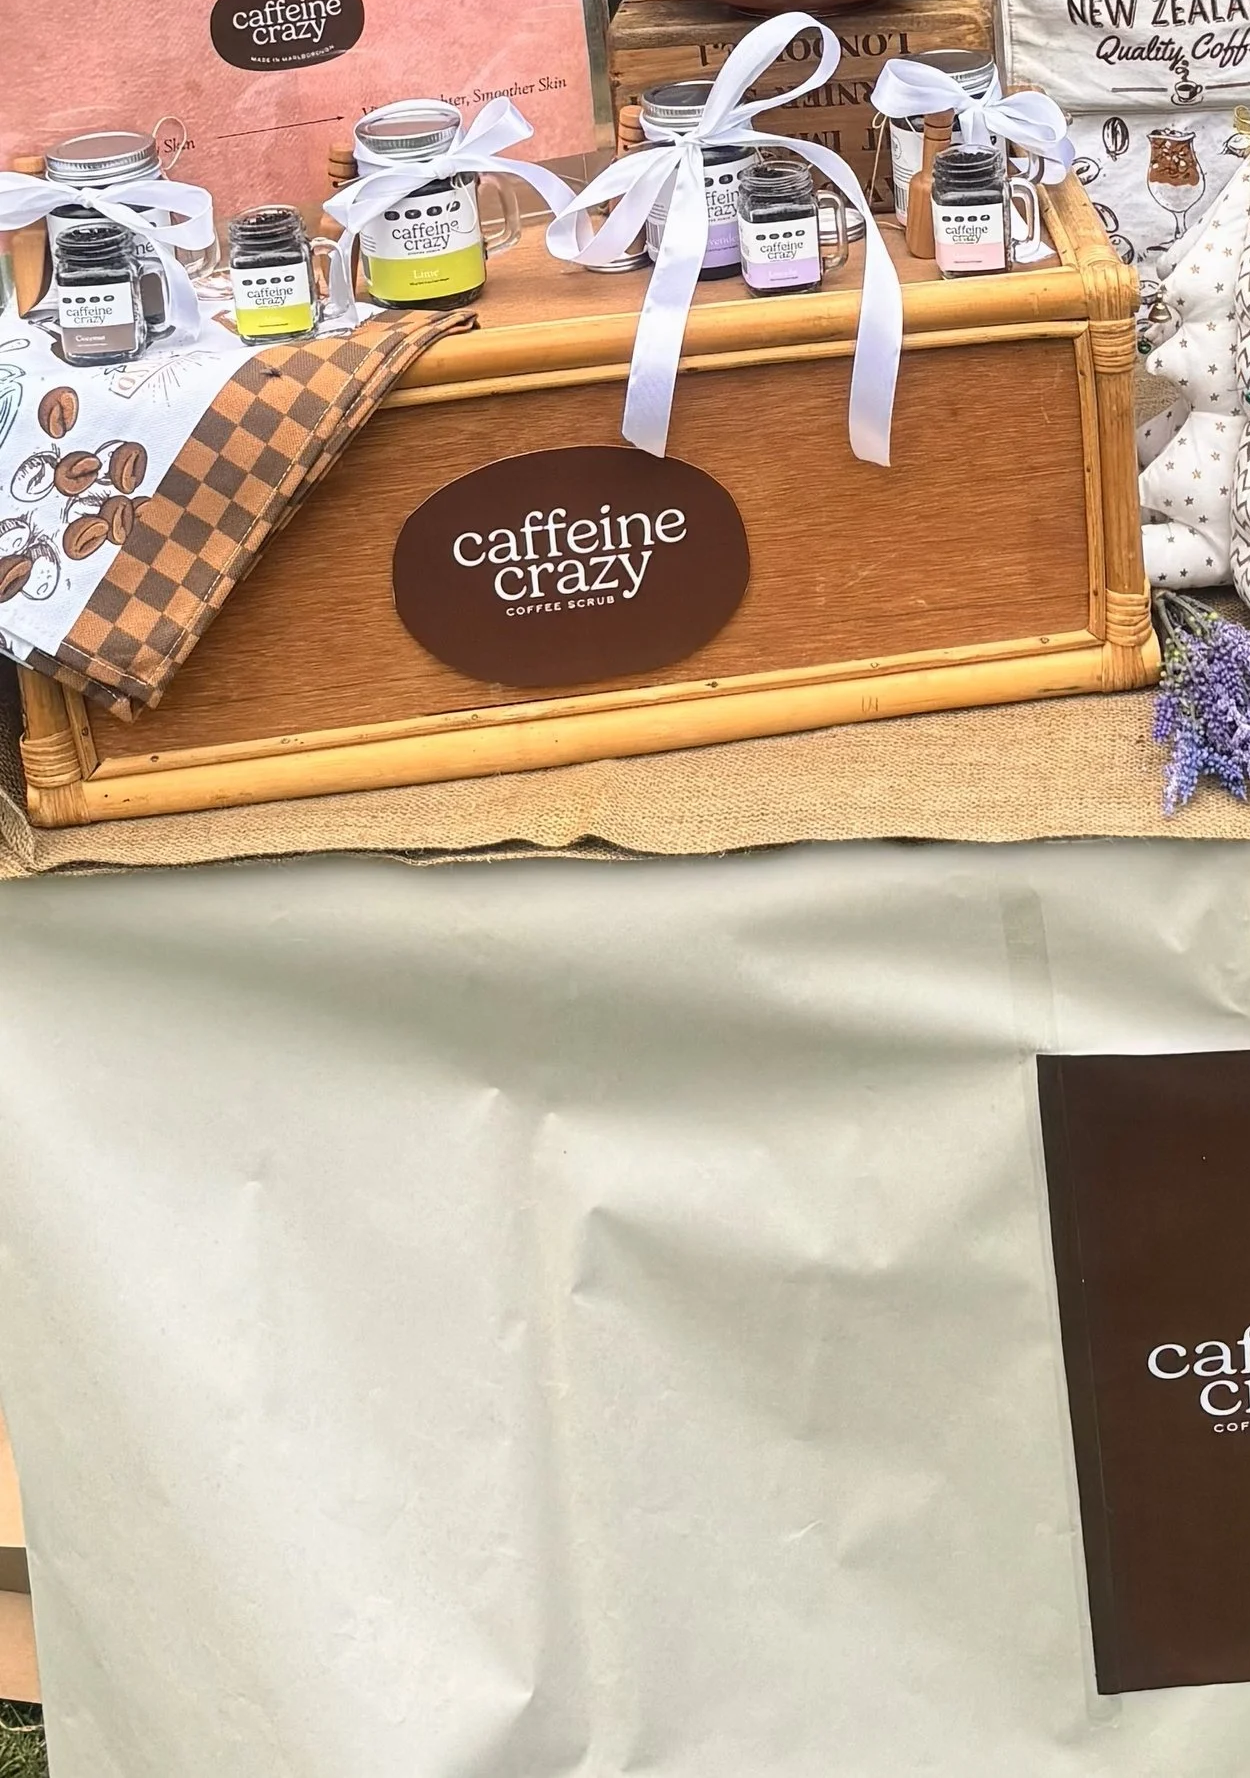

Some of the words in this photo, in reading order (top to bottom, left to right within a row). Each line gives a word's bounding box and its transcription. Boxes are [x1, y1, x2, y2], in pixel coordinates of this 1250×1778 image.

[252, 18, 326, 45] crazy
[1096, 35, 1186, 71] Quality
[538, 77, 568, 93] Skin
[708, 203, 738, 218] razy
[391, 220, 459, 240] caffeine
[945, 225, 989, 235] caffeine
[403, 234, 450, 251] crazy
[760, 241, 804, 253] caffeine
[767, 251, 797, 260] crazy
[413, 269, 440, 280] Lime
[247, 287, 293, 299] caffeine
[255, 296, 287, 306] crazy
[66, 304, 113, 318] caffeine
[73, 315, 106, 325] crazy
[453, 504, 688, 568] caffeine
[493, 550, 653, 602] crazy
[505, 600, 563, 616] COFFEE
[567, 595, 616, 610] SCRUB
